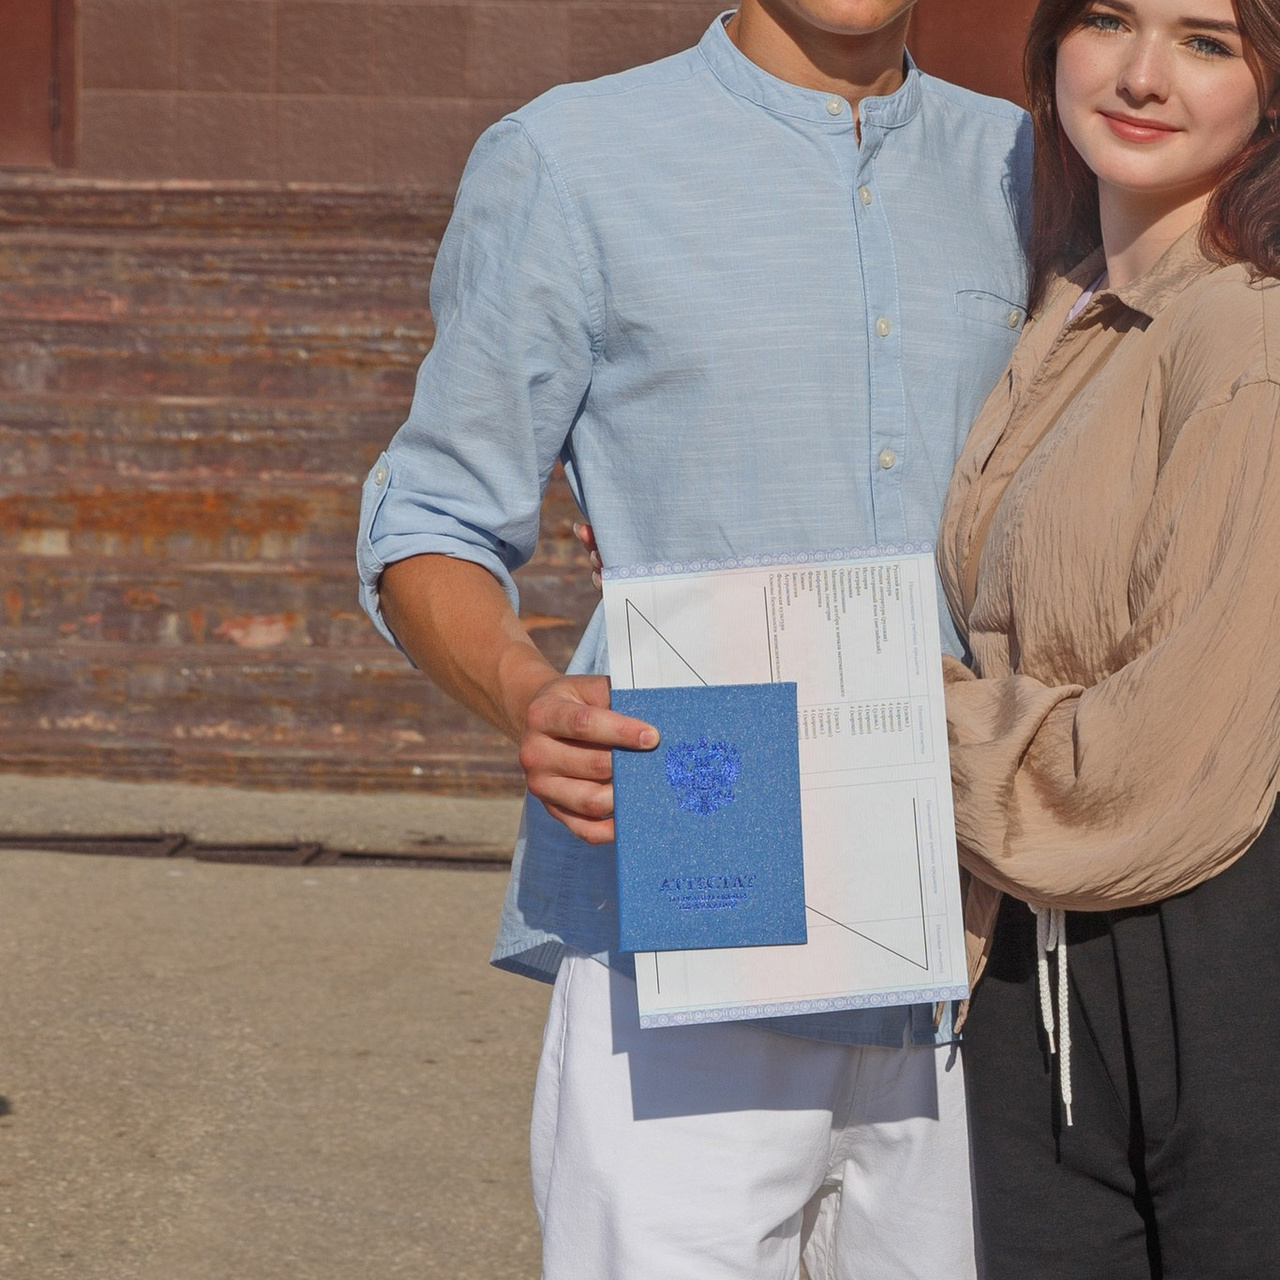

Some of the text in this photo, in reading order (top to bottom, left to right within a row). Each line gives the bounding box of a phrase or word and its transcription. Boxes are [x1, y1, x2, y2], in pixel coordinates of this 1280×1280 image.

[783, 573, 791, 606] Астрономия
[814, 570, 823, 607] Информатика
[839, 568, 847, 613] Обществознание
[869, 566, 878, 602] Иностранный
[884, 565, 893, 596] Литература
[770, 596, 778, 632] безопасности
[872, 617, 881, 654] (английский)
[880, 616, 888, 642] (русская)
[837, 651, 845, 697] математического
[802, 713, 810, 739] (хорошо)
[825, 712, 833, 737] (хорошо)
[856, 709, 864, 735] (хорошо)
[864, 708, 872, 734] (хорошо)
[880, 707, 888, 733] (хорошо)
[887, 706, 895, 732] (хорошо)
[895, 706, 903, 731] (хорошо)
[660, 874, 756, 892] АТТЕСТАТ
